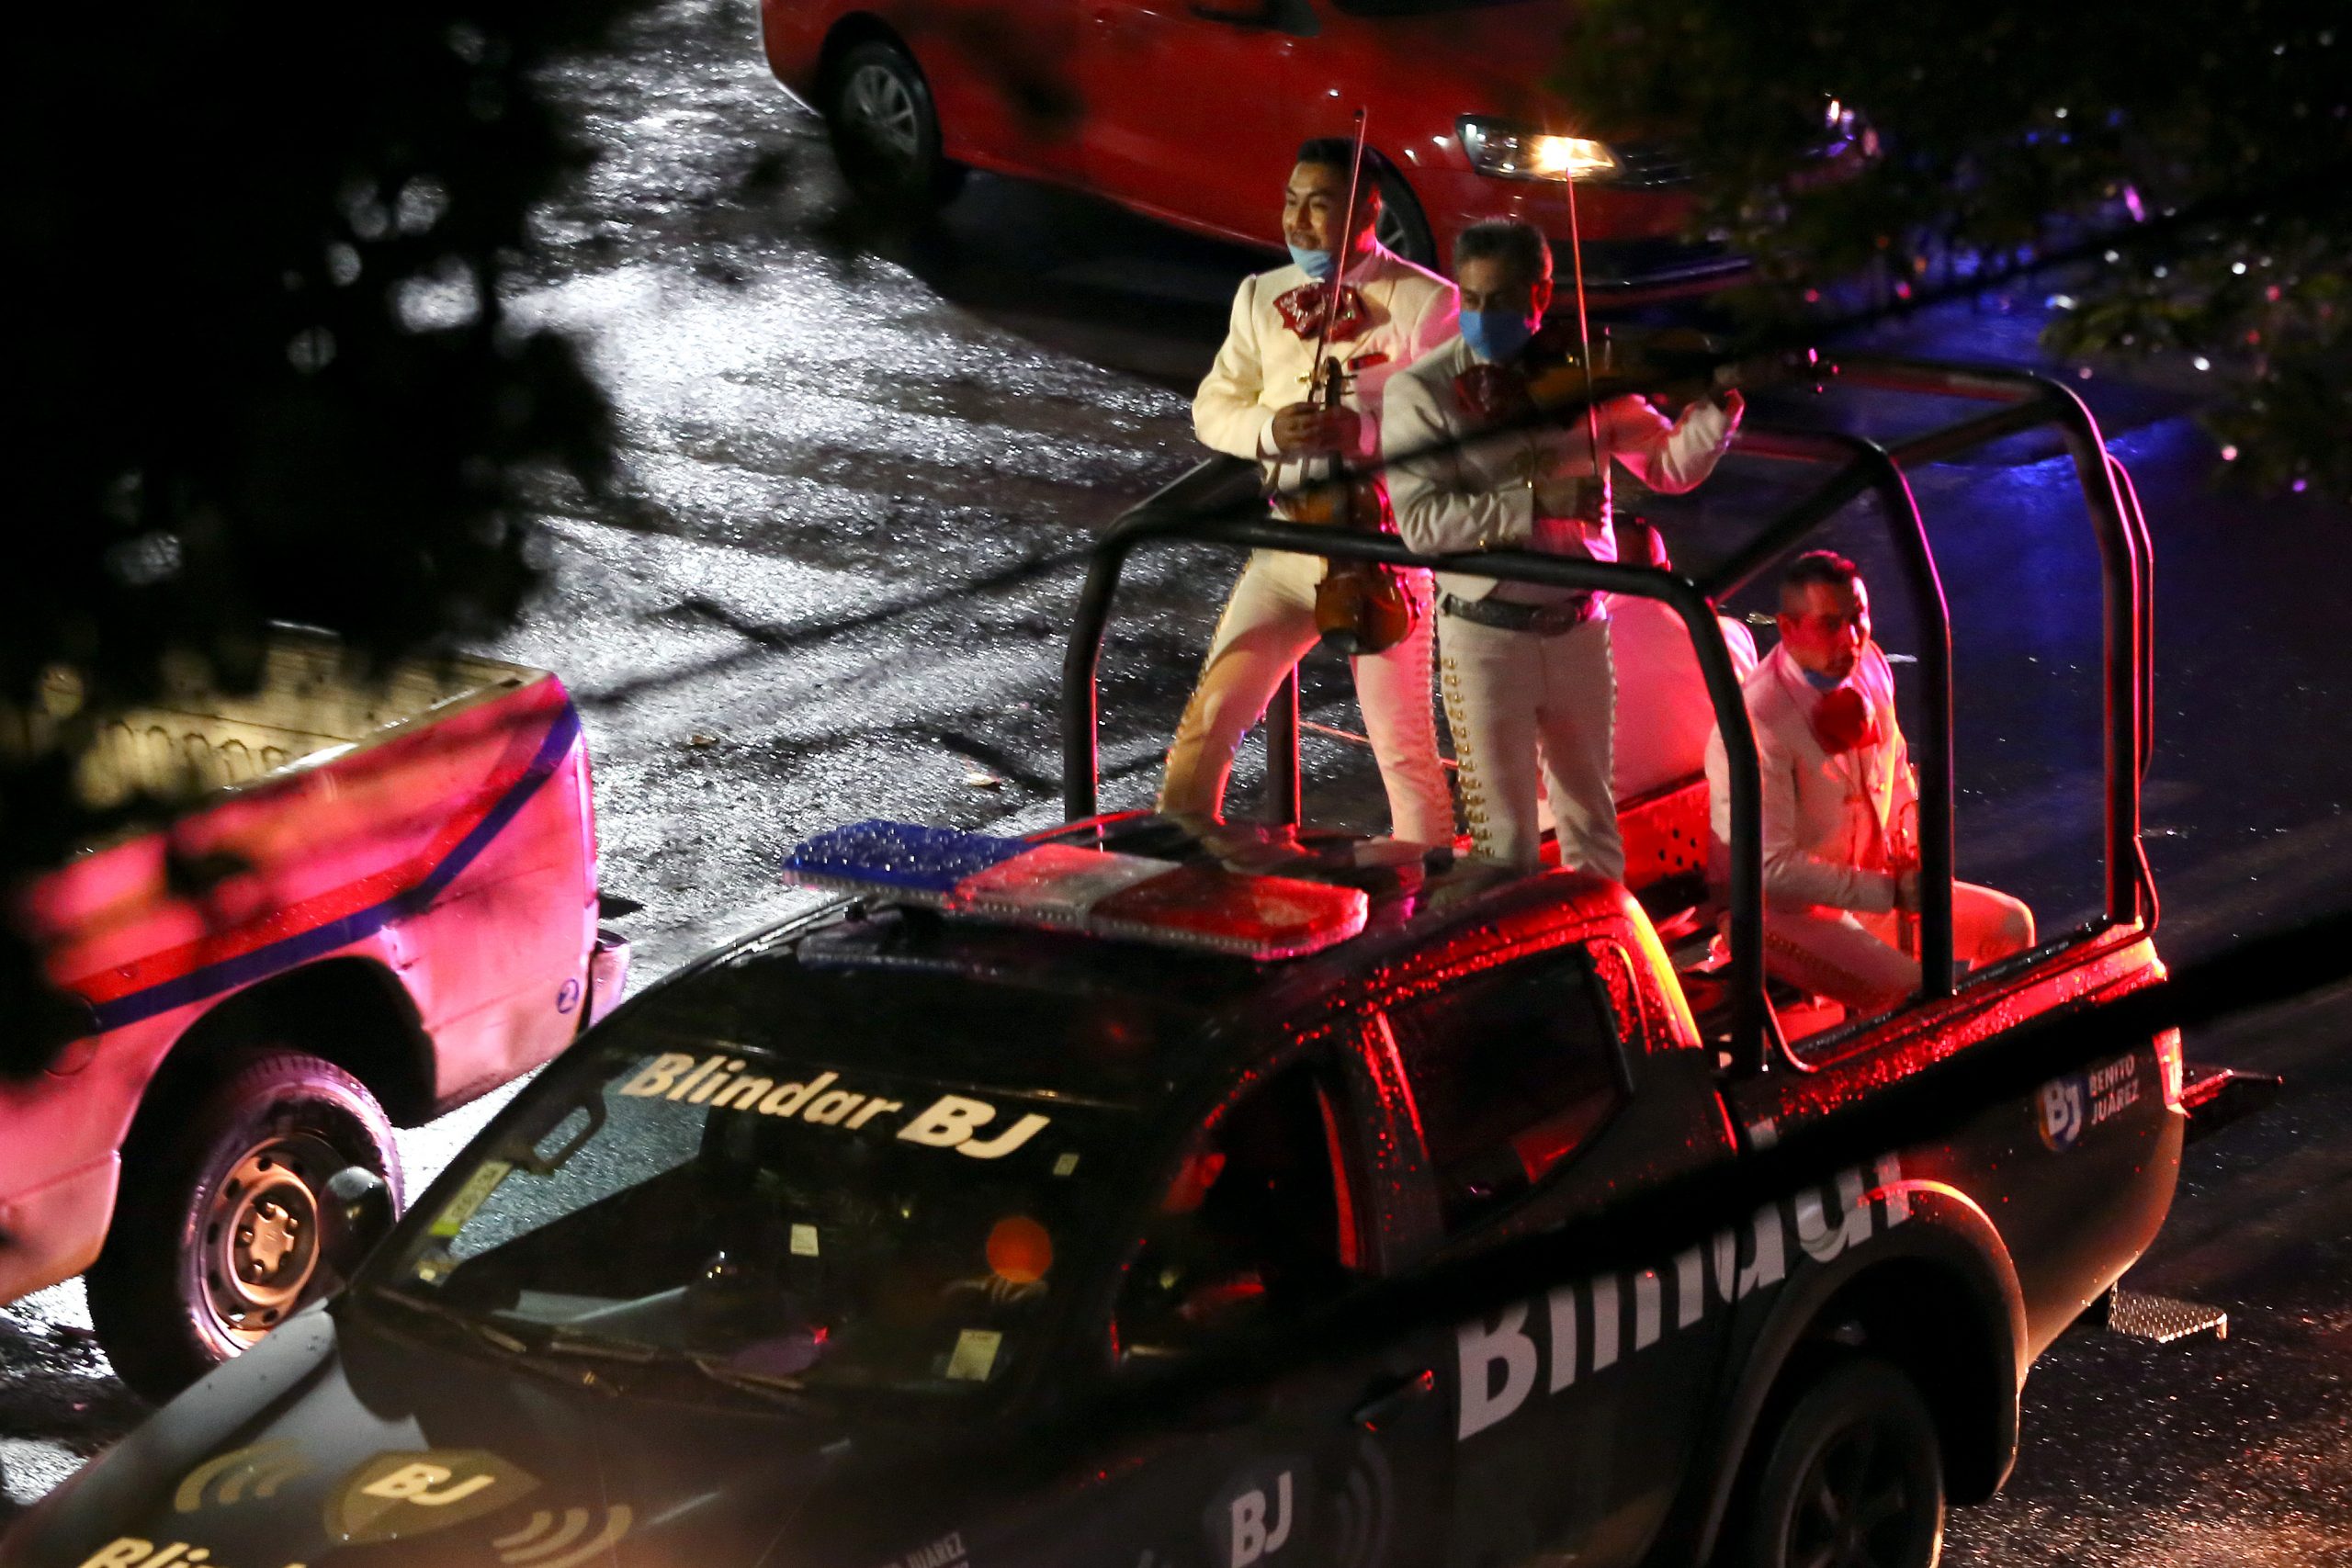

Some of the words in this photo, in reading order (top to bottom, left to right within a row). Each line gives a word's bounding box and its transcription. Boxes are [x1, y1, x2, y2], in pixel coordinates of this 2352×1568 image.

[618, 1052, 904, 1130] Blindar
[896, 1094, 1052, 1160] BJ
[2088, 1054, 2136, 1099] BENITO
[2042, 1081, 2083, 1143] BJ
[361, 1463, 496, 1507] BJ
[1231, 1471, 1293, 1568] BJ
